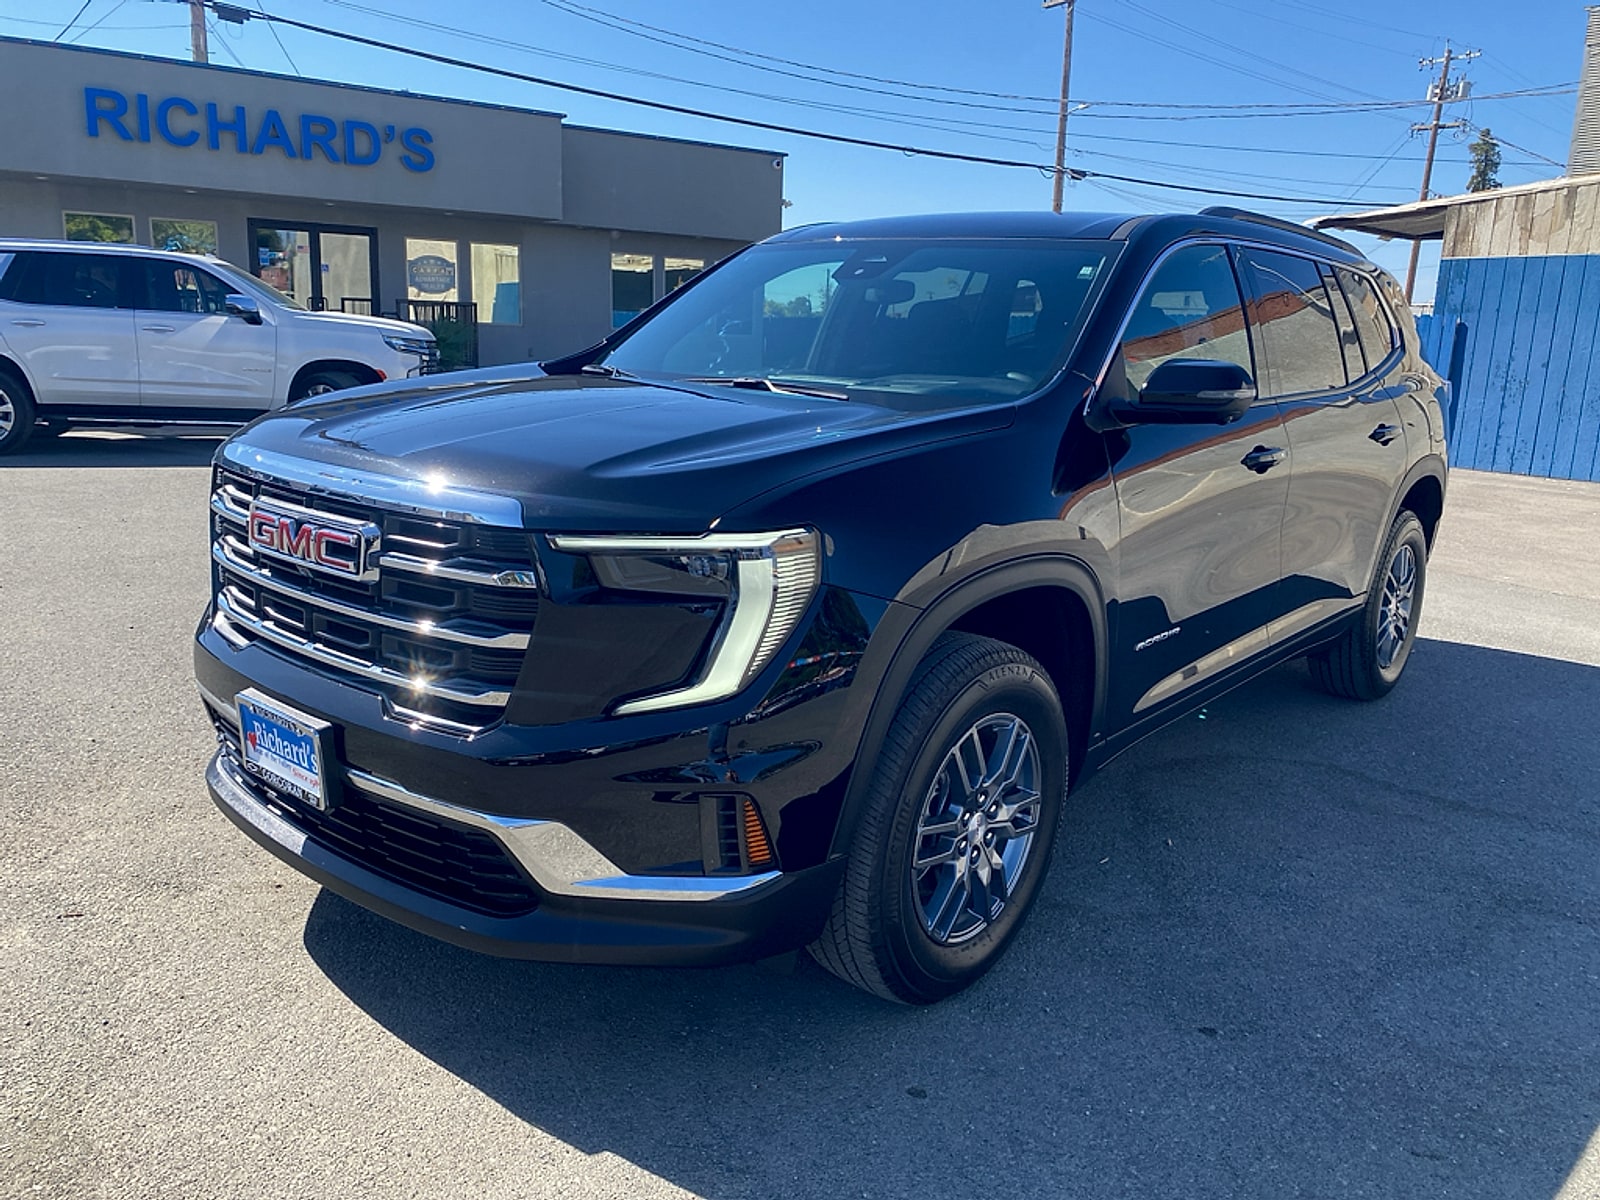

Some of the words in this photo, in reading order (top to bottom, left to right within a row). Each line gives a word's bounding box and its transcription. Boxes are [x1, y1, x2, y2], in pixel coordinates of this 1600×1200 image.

[84, 87, 436, 173] RICHARD'S
[250, 508, 358, 572] GMC
[1135, 626, 1181, 651] ACADIA
[988, 665, 1028, 681] ALENZA
[252, 720, 319, 773] Richard's
